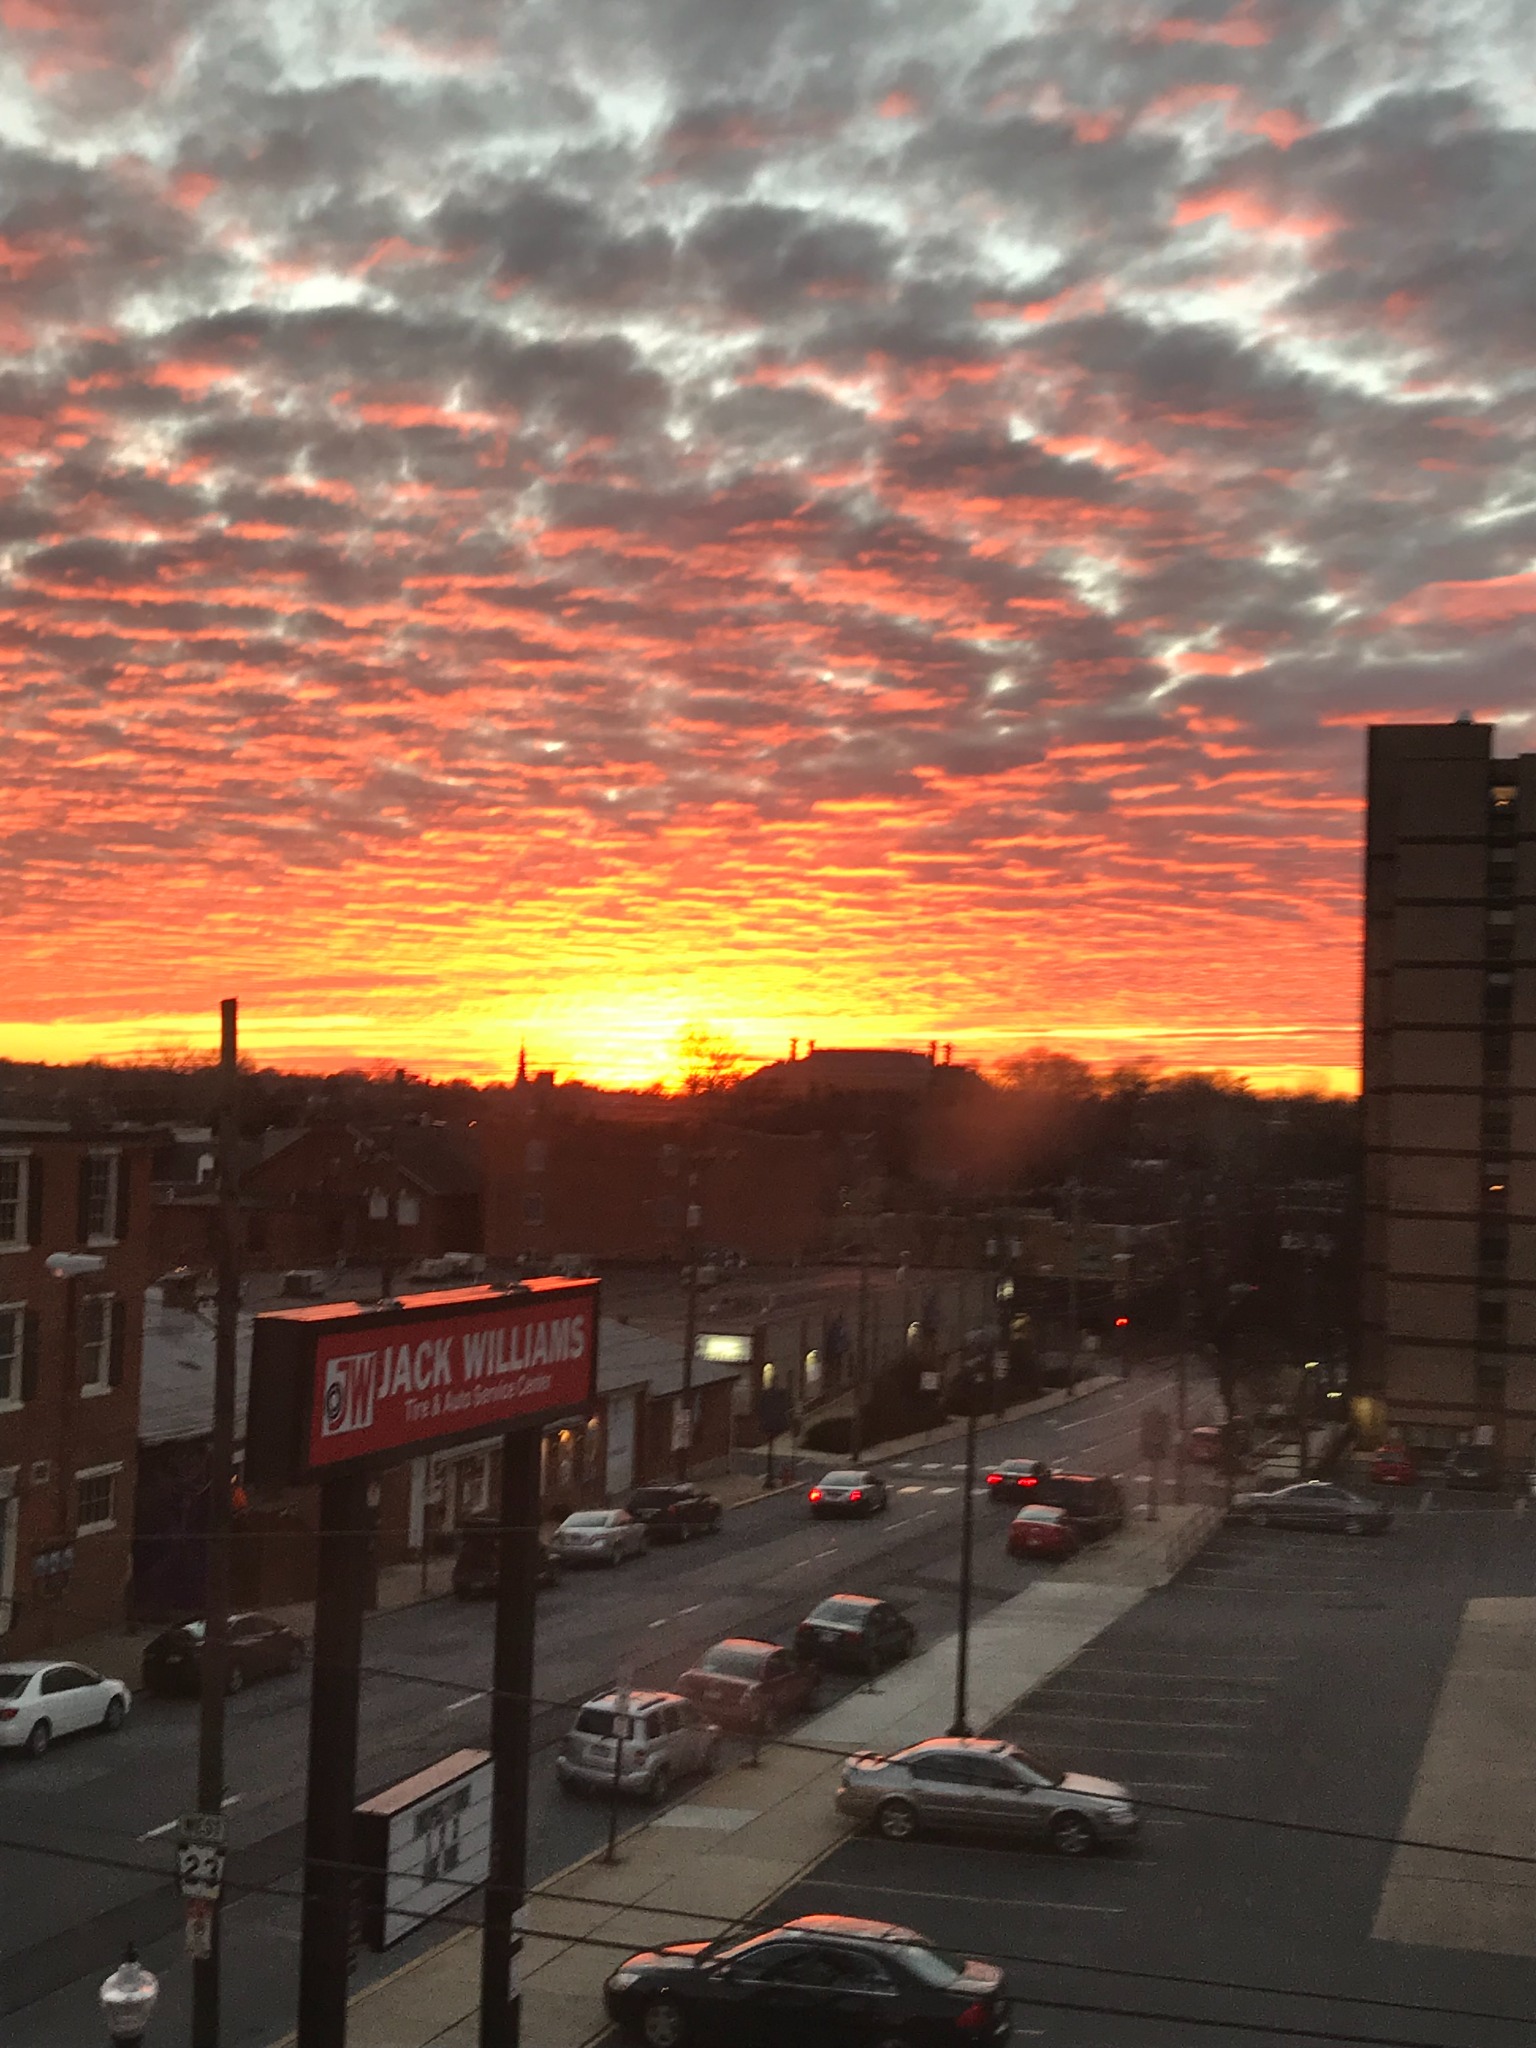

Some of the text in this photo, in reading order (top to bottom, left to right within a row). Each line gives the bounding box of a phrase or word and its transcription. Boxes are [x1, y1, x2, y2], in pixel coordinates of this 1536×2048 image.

[378, 1316, 585, 1400] JACK WILLIAMS
[404, 1397, 430, 1423] Tire
[431, 1392, 442, 1417] &
[444, 1389, 471, 1413] Auto
[473, 1379, 516, 1408] Service
